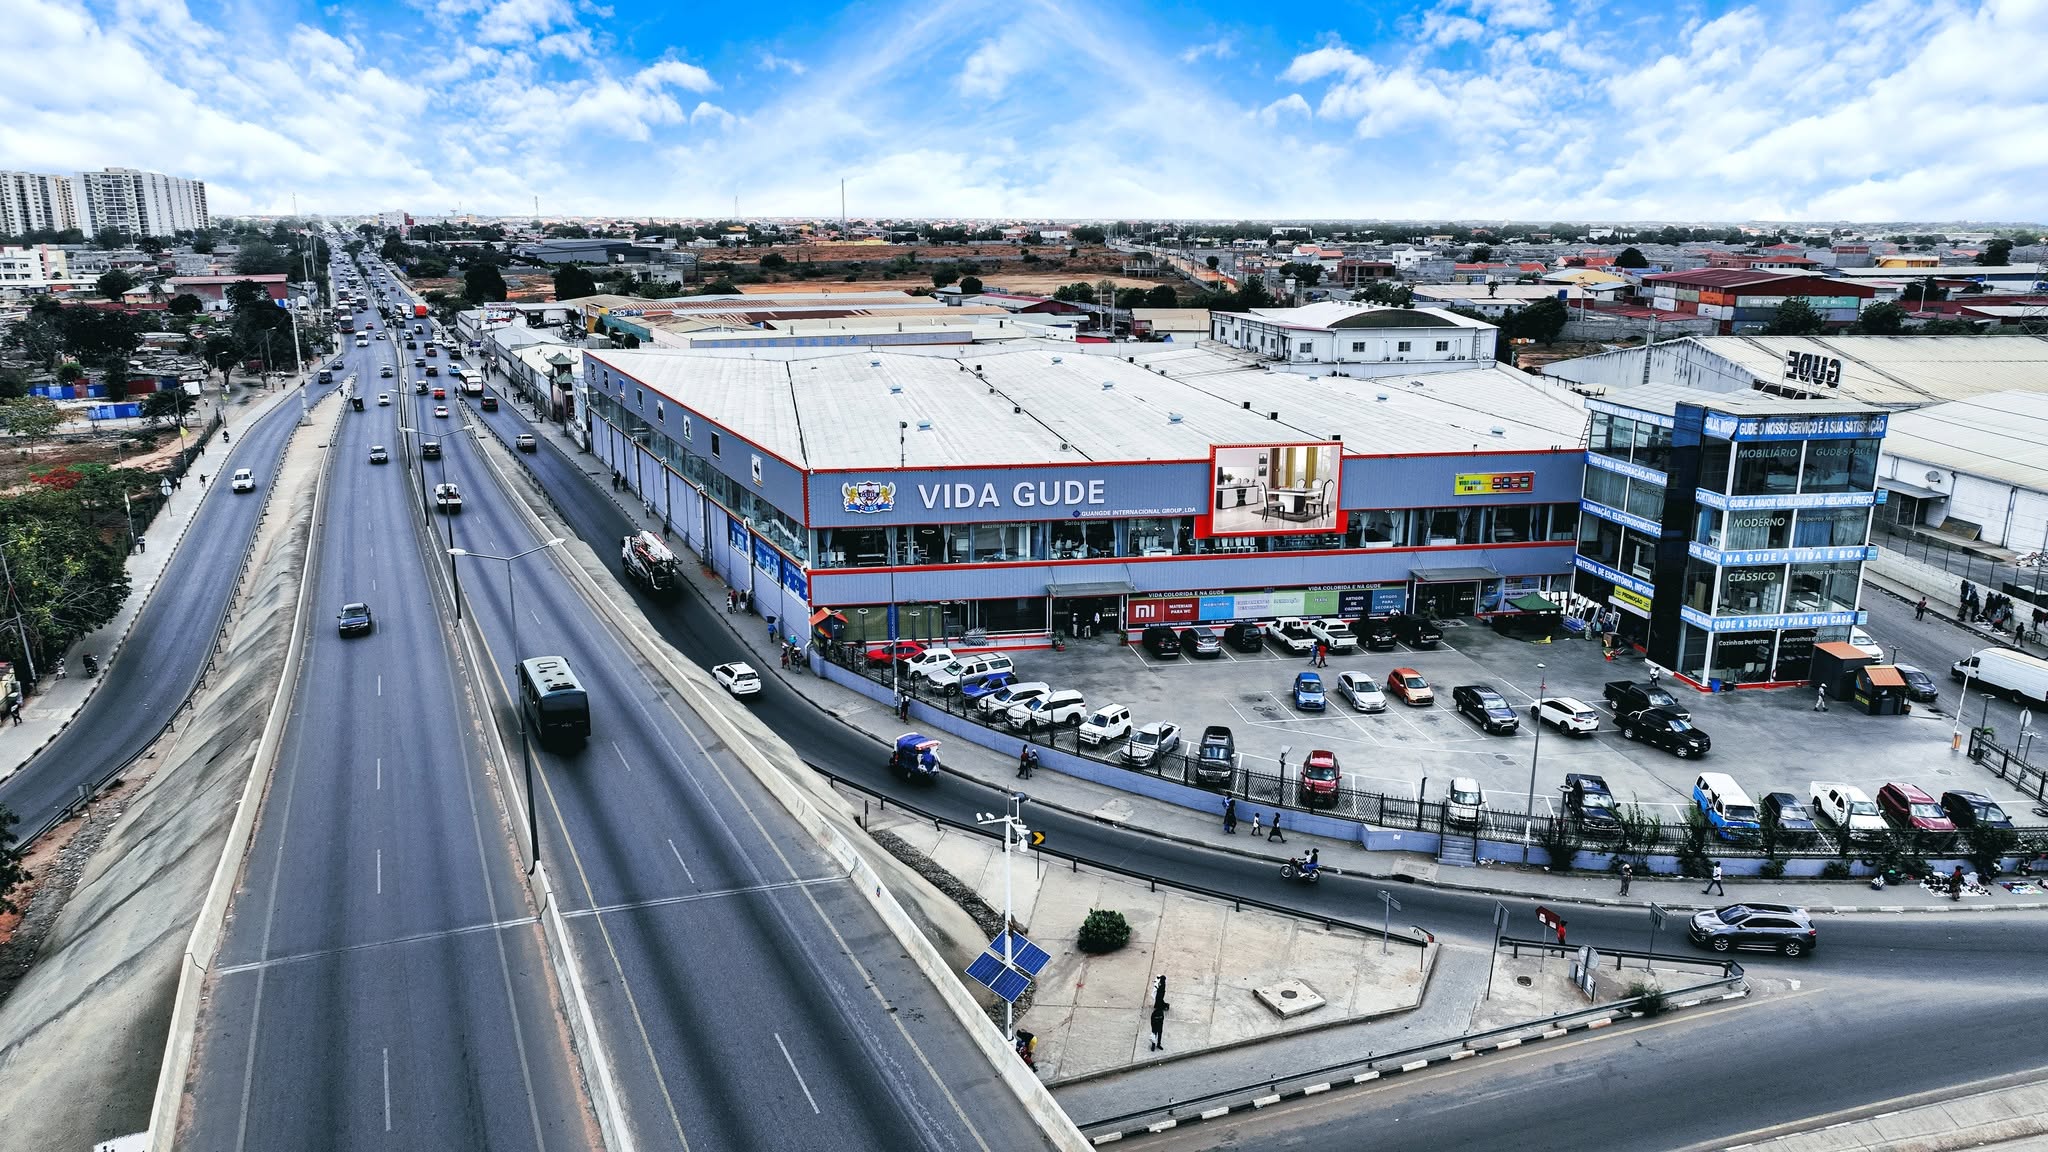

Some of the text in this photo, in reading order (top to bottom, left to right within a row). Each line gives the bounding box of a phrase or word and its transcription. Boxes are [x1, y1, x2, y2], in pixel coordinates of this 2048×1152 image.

[1739, 422, 1758, 435] GUDE
[1759, 423, 1764, 435] O
[1765, 421, 1788, 435] NOSSO
[1789, 420, 1817, 437] SERVIÇO
[1817, 418, 1824, 434] É
[1824, 421, 1829, 434] A
[1829, 420, 1843, 434] SUA
[1738, 446, 1798, 458] MOBILIÁRIO
[1588, 455, 1601, 466] TUDO
[1601, 458, 1615, 470] PARA
[917, 479, 1105, 509] VIDA GUDE
[1729, 494, 1874, 508] GUDE A MAIOR QUALIDADE AO MELHOR PREÇO
[1112, 508, 1160, 516] INTERNACIONAL
[1733, 517, 1785, 528] MODERNO
[1725, 548, 1865, 563] NA GUDE A VIDA É BOA.
[1575, 557, 1598, 574] MATERIAL
[1597, 566, 1605, 577] DE
[1728, 570, 1776, 582] CLÁSSICO
[1714, 614, 1855, 630] GUDE A SOLUÇÃO PARA SUA CASA.
